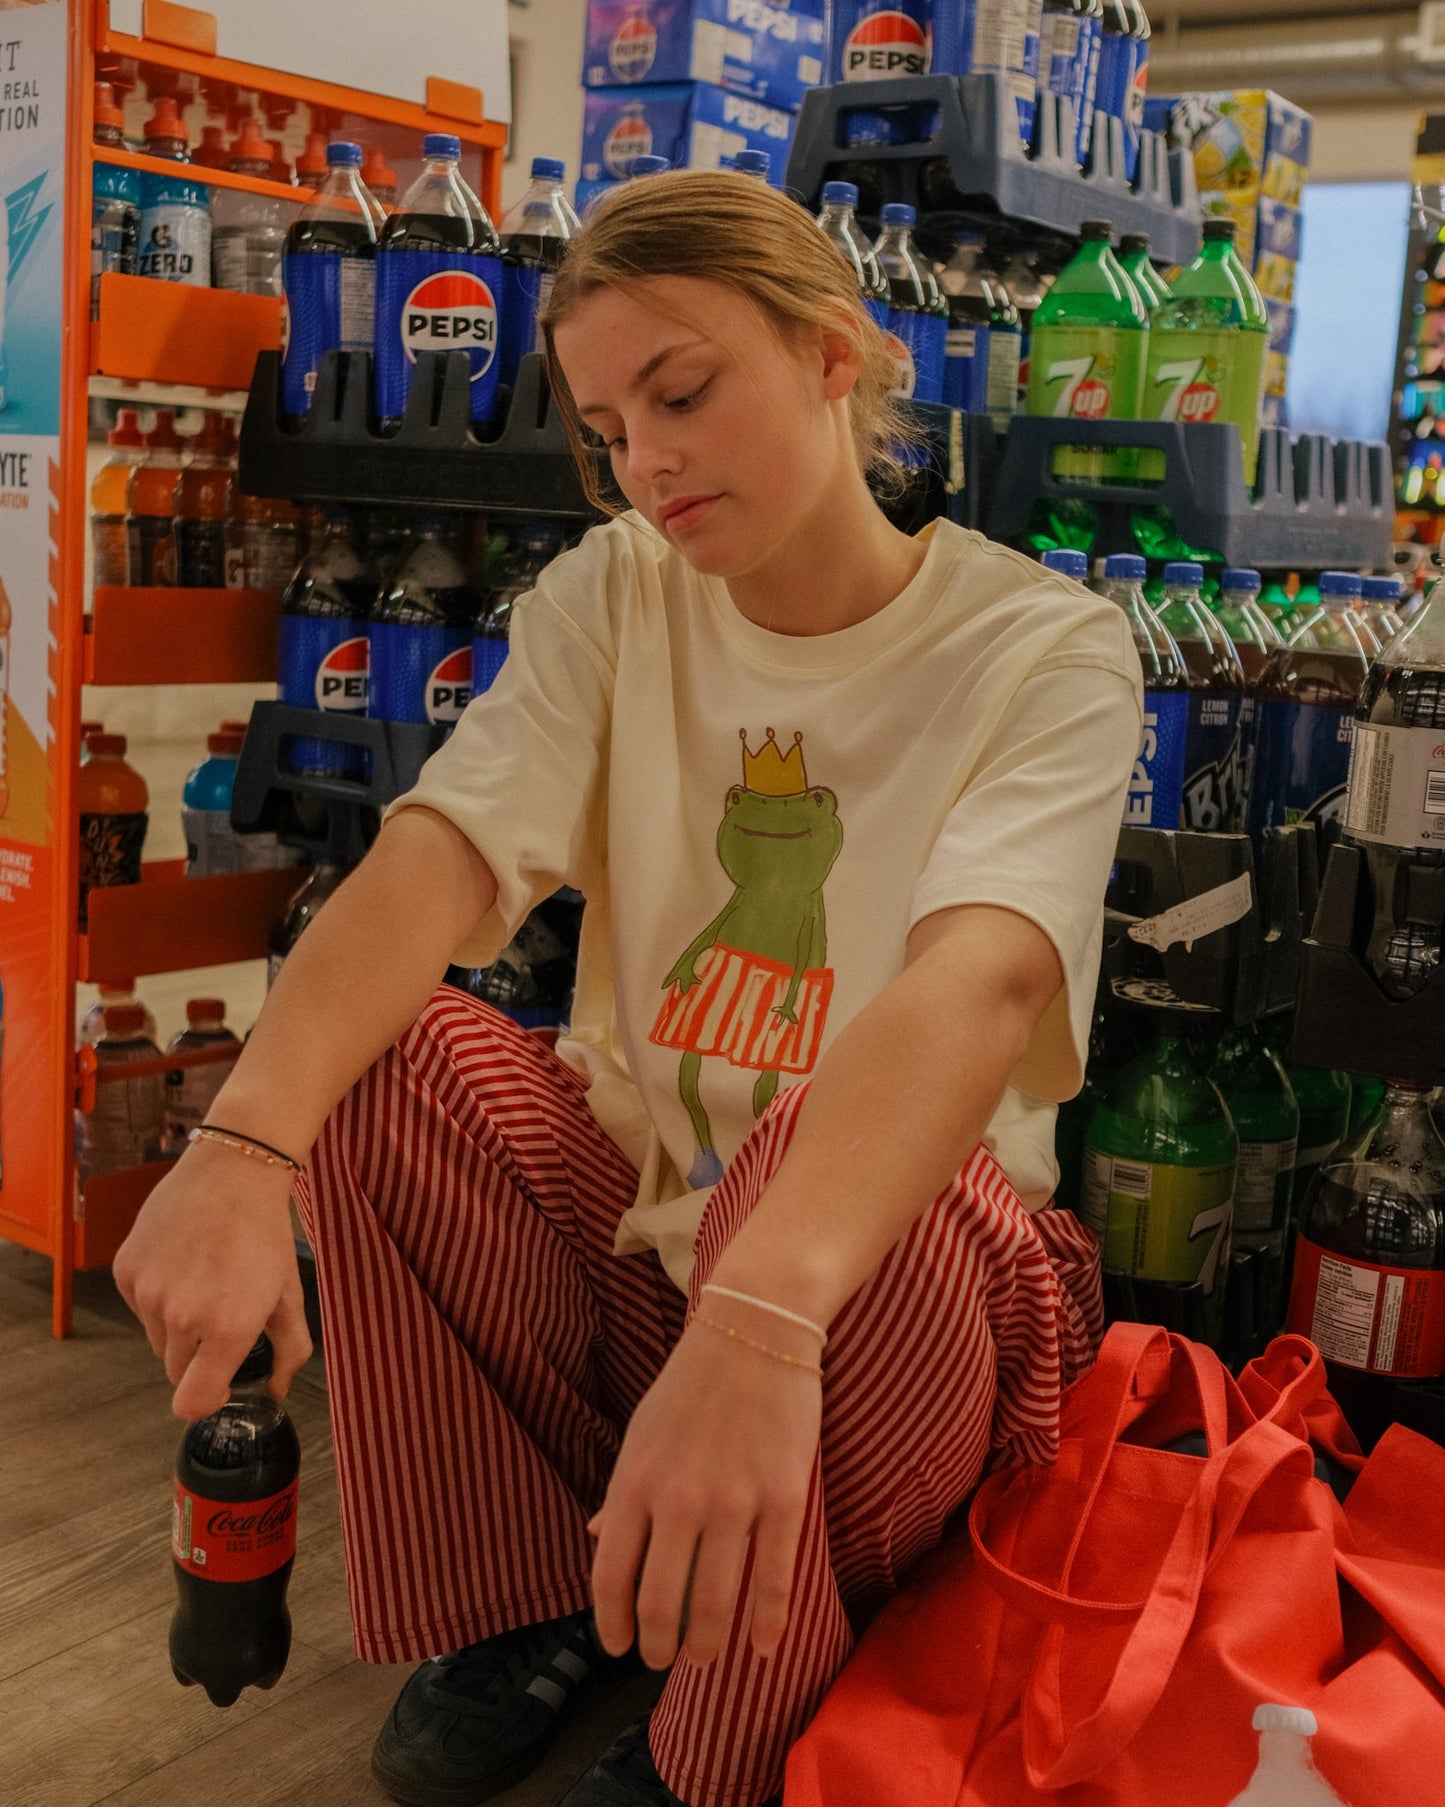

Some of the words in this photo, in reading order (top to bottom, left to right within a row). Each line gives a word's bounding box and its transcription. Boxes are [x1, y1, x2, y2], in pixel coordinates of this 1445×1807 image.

[850, 50, 925, 75] PEPSI
[4, 80, 39, 100] REAL
[723, 95, 789, 139] PEPSI
[139, 254, 193, 274] ZERO
[408, 315, 493, 341] PEPSI
[323, 677, 368, 698] PE
[1202, 700, 1229, 712] LEMON
[1201, 713, 1228, 726] CITRON
